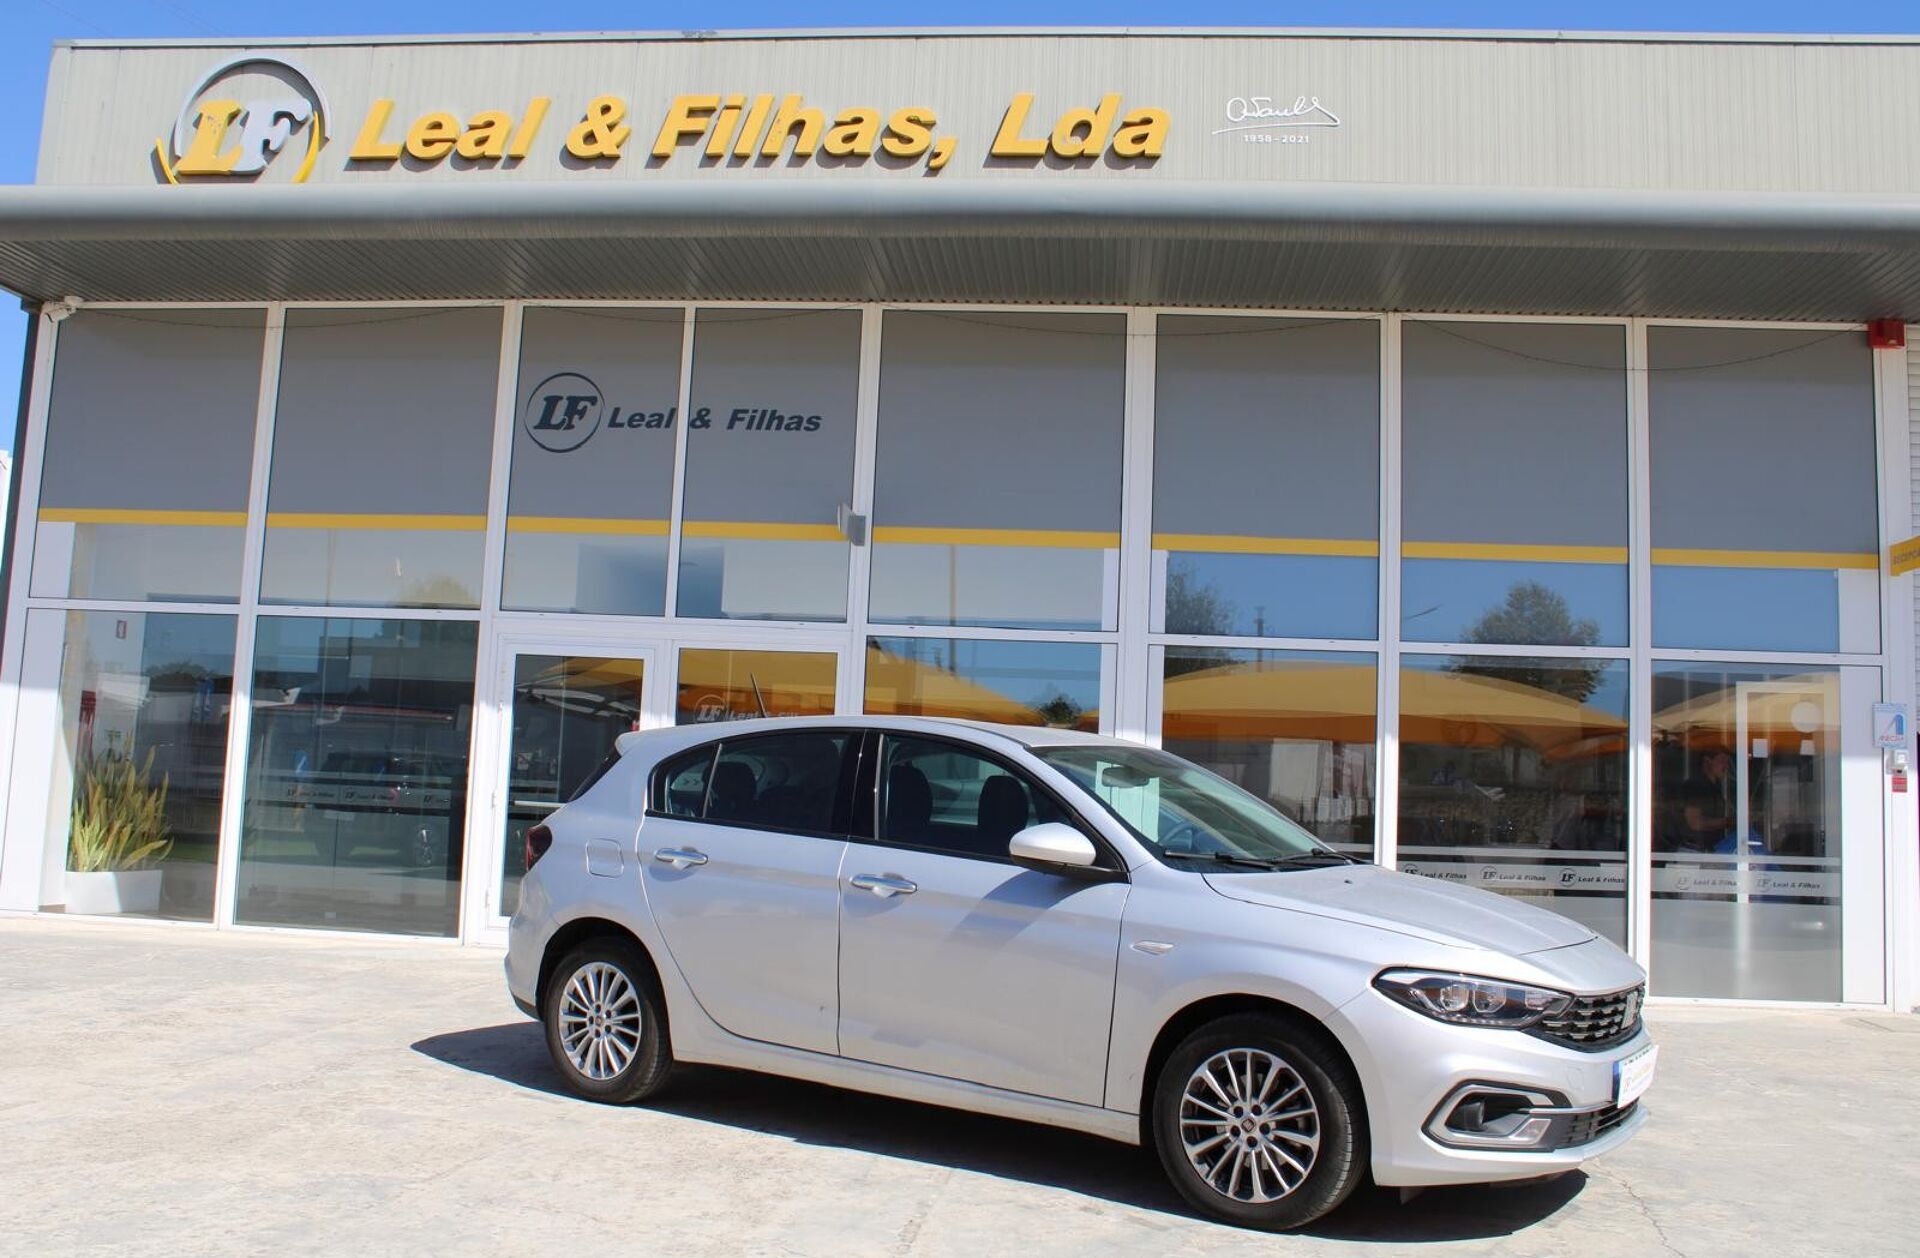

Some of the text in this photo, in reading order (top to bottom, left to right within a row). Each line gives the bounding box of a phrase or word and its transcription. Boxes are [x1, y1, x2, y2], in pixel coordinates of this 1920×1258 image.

[175, 98, 313, 176] LF
[350, 97, 550, 161] Leal
[566, 96, 631, 160] &
[652, 94, 958, 170] Filhas,
[991, 94, 1172, 158] Lda
[533, 395, 822, 432] LF Leal & Filhas
[697, 705, 725, 722] LF
[1561, 873, 1576, 882] LF
